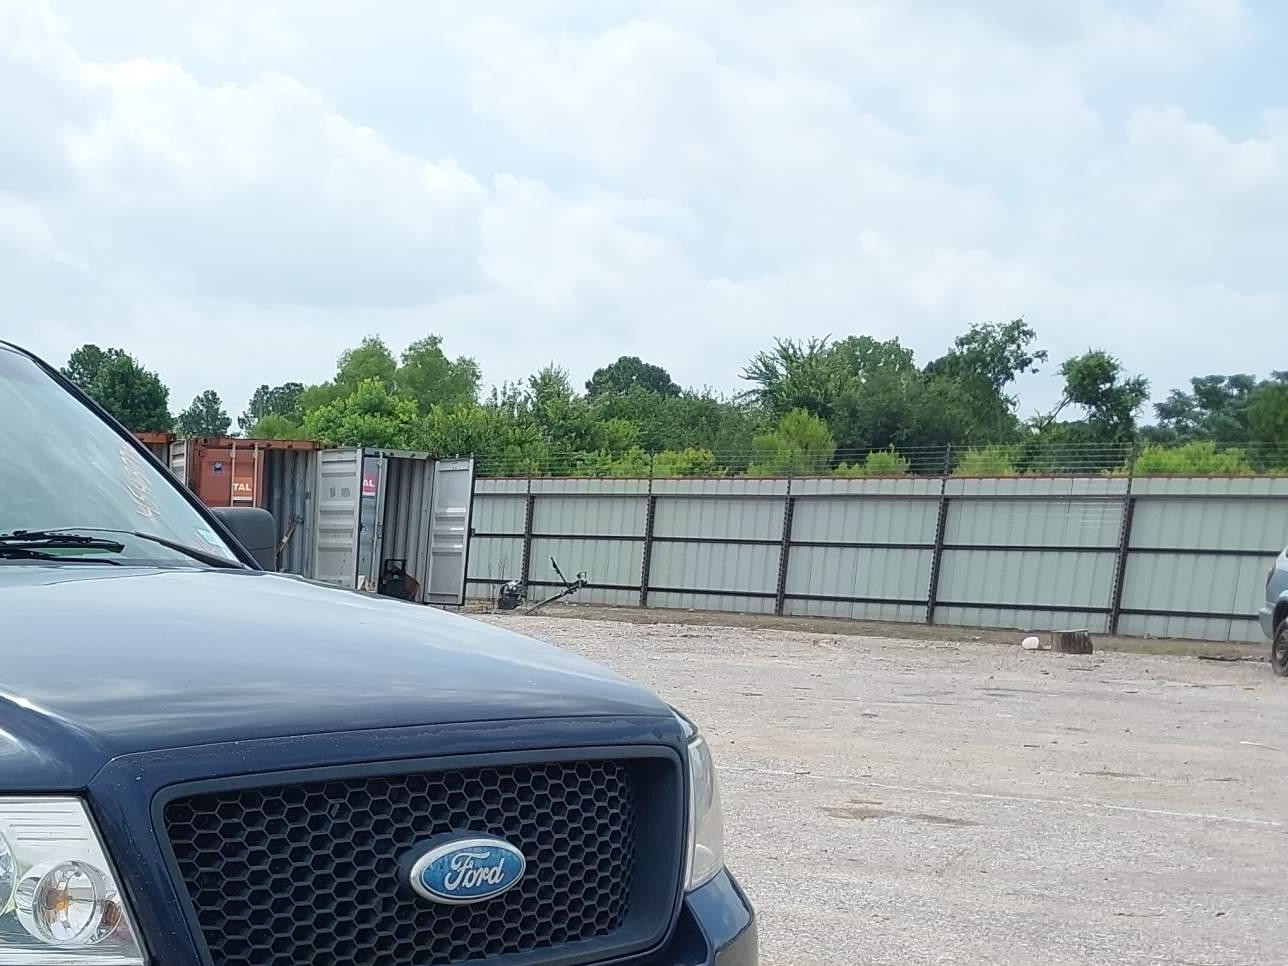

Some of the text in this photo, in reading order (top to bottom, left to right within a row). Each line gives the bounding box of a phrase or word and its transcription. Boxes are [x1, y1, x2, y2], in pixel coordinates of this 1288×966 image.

[233, 482, 253, 492] TAL
[362, 479, 376, 488] AL
[444, 851, 505, 891] Ford
